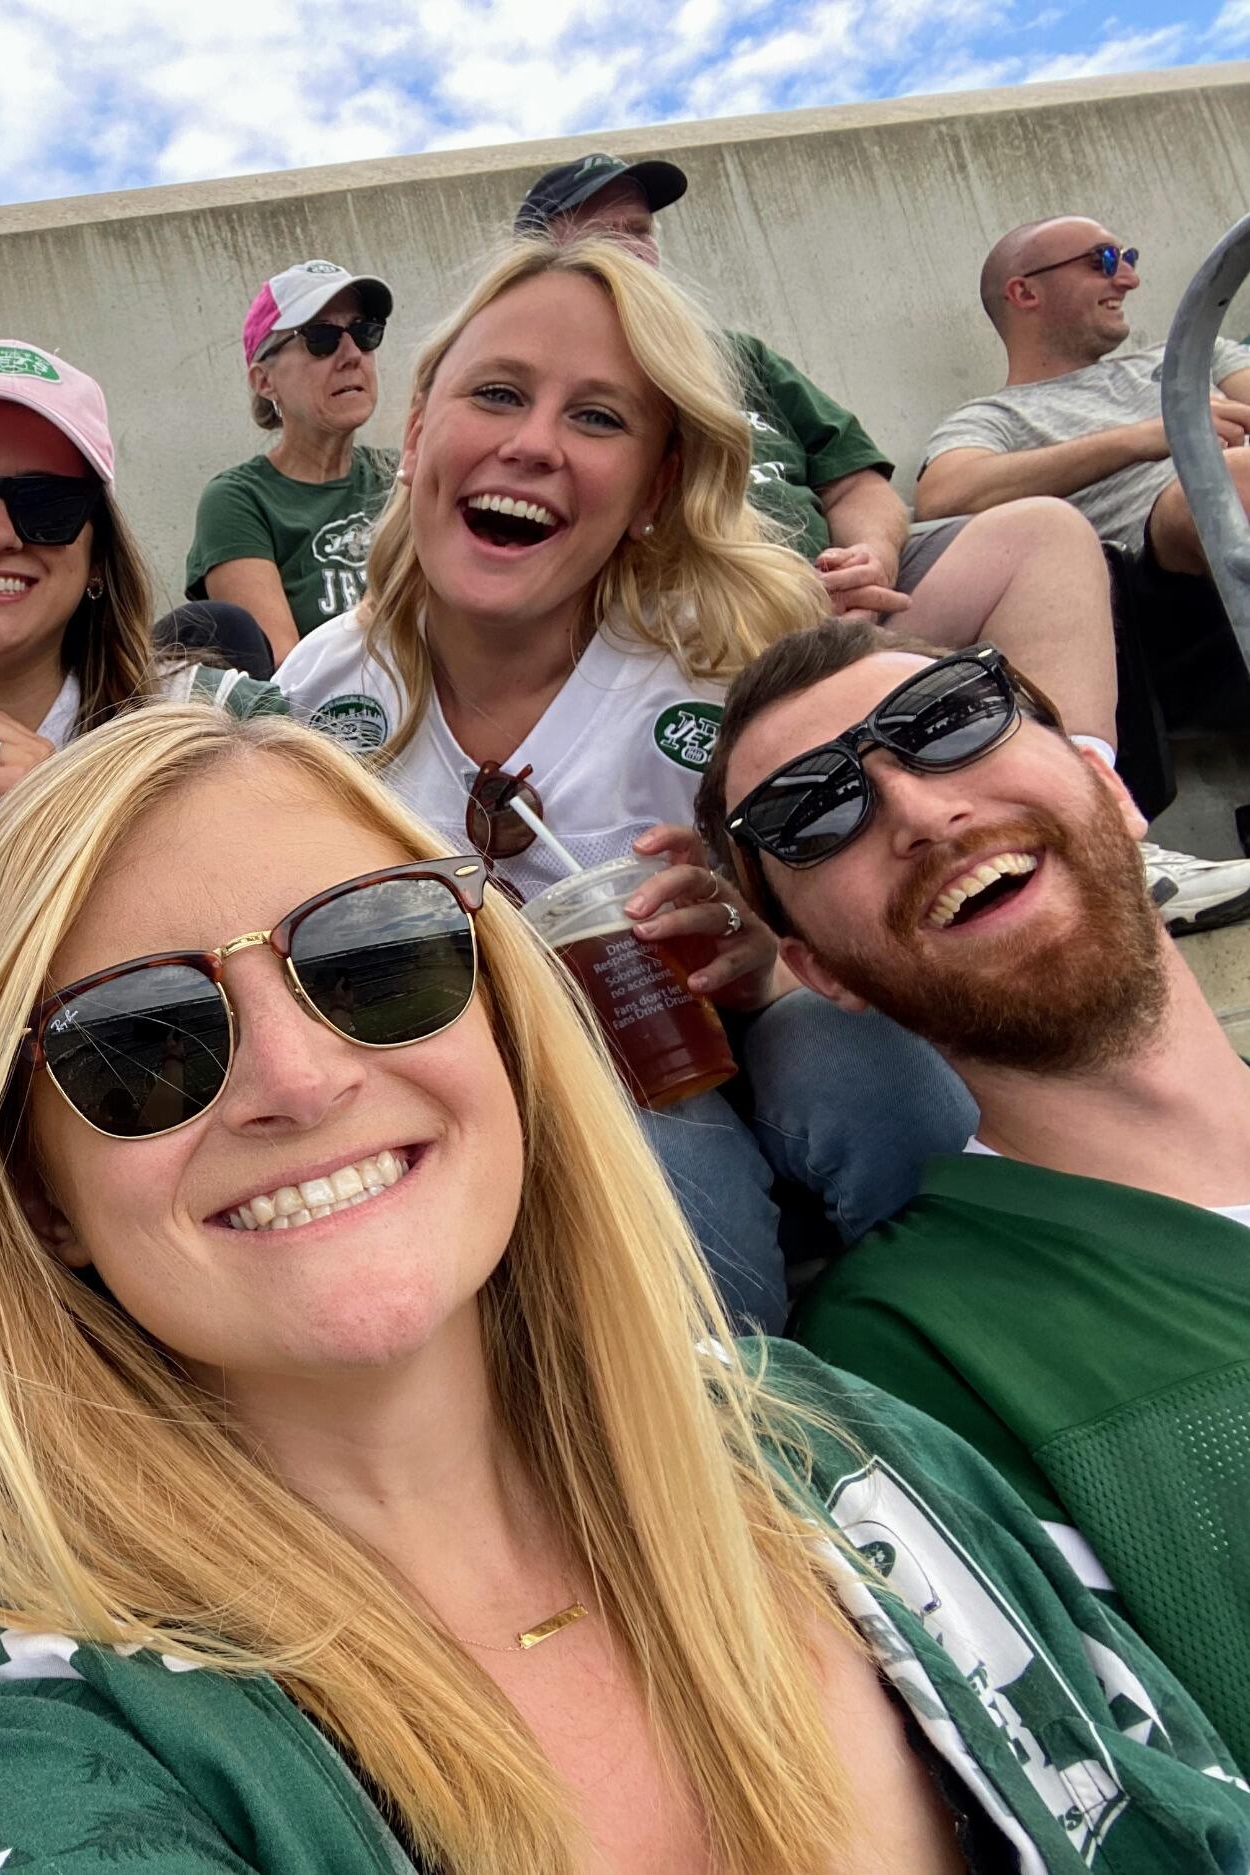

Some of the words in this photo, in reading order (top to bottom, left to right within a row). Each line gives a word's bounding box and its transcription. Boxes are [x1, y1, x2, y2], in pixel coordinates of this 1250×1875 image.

[318, 569, 367, 615] JE
[611, 987, 625, 999] no
[613, 1014, 636, 1030] Fans
[635, 1002, 664, 1019] Drive
[614, 1001, 638, 1017] Fans
